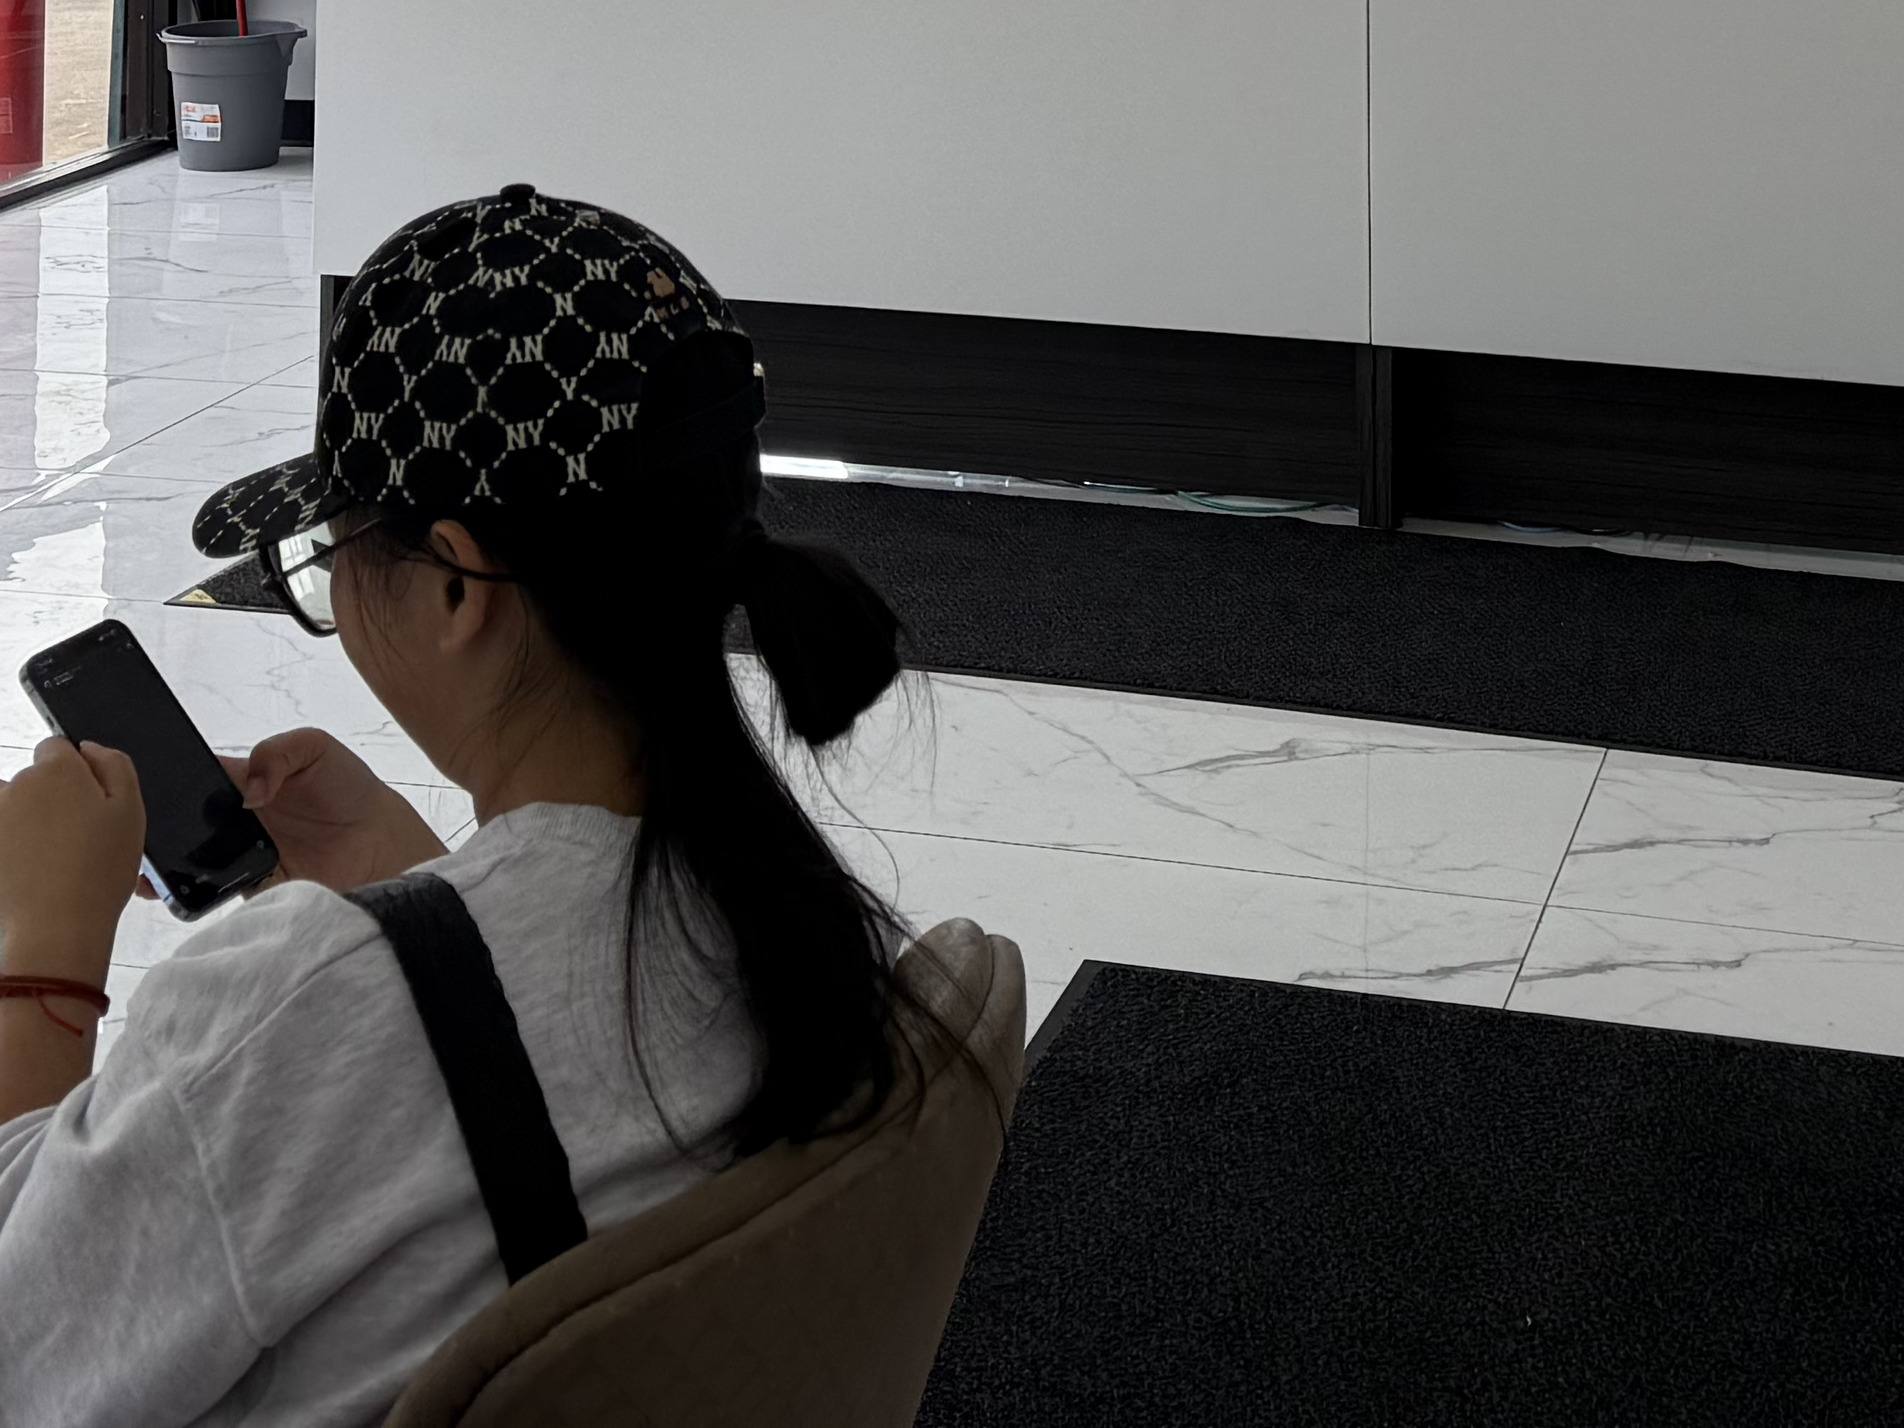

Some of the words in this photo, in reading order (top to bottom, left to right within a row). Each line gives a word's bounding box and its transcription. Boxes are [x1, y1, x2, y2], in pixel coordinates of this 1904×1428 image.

[583, 258, 619, 282] NY
[352, 412, 385, 441] NY
[601, 402, 640, 433] NY
[422, 420, 458, 451] NY
[505, 418, 545, 451] NY
